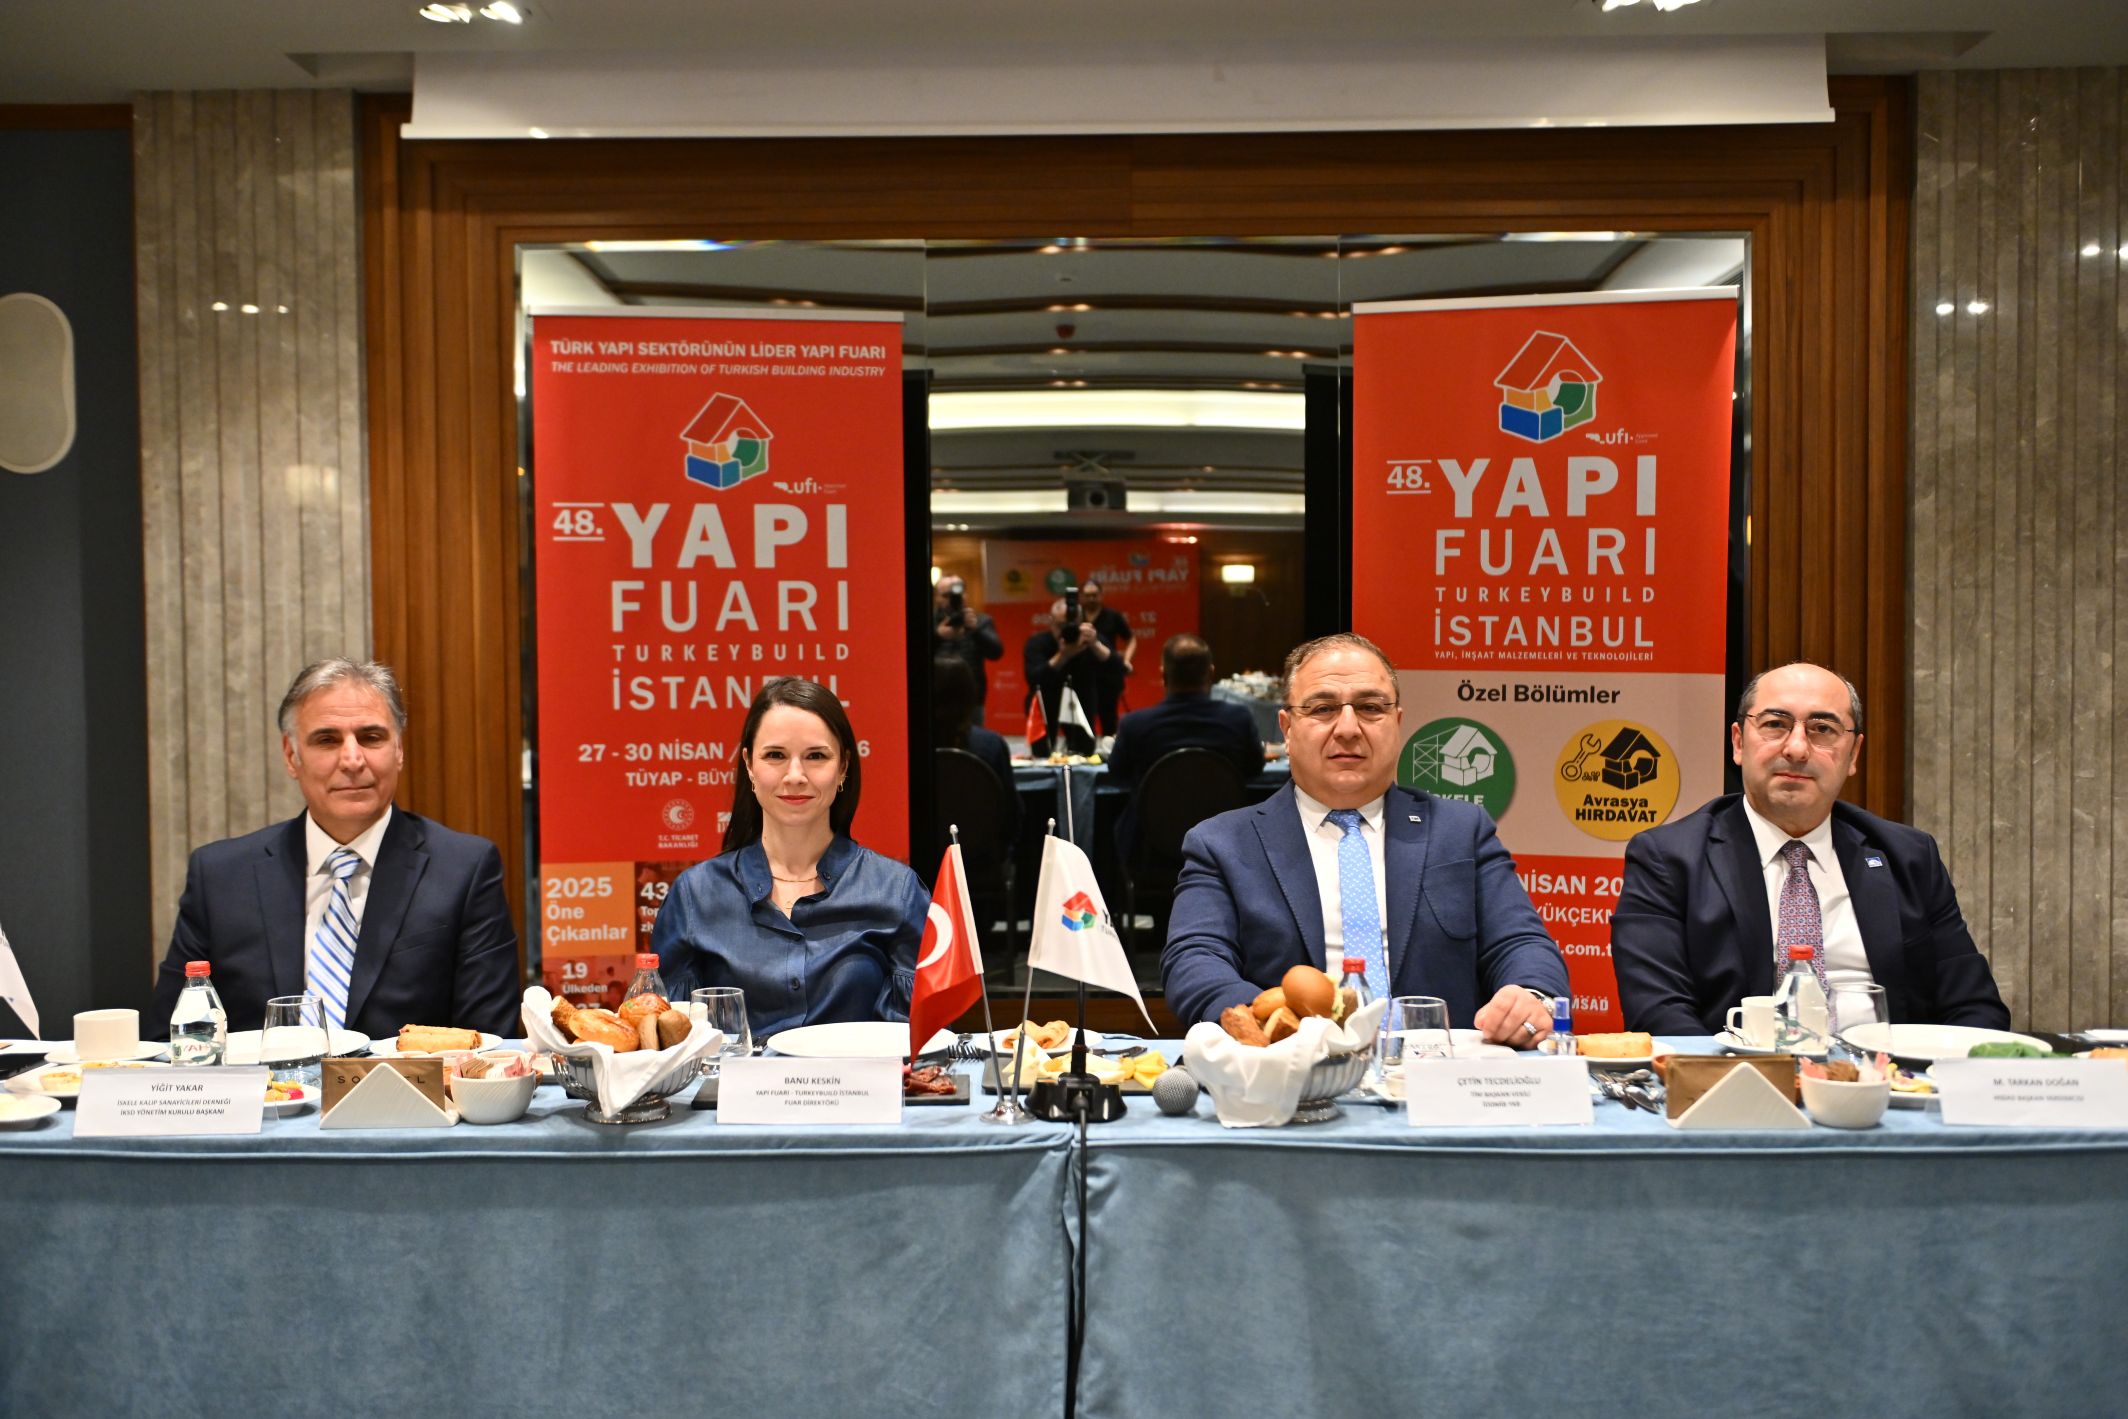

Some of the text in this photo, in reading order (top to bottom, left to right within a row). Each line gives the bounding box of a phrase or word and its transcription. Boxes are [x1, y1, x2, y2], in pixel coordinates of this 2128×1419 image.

[550, 338, 886, 359] TÜRK YAPI SEKTÖRÜNÜN LİDER YAPI FUARI
[552, 361, 886, 377] THE LEADING EXHIBITION OF TURKISH BUILDING INDUSTRY
[1387, 465, 1430, 489] 48.
[1437, 455, 1657, 518] YAPI
[553, 510, 603, 535] 48.
[611, 503, 848, 569] YAPI
[1435, 528, 1656, 576] FUARI
[1435, 587, 1655, 603] TURKEYBUILD
[611, 580, 849, 632] FUARI
[1434, 608, 1654, 647] İSTANBUL
[612, 644, 850, 662] TURKEYBUILD
[1434, 650, 1654, 662] YAPI, İNŞAAT MALZEMELERİ VE TEKNOLOJİLERİ
[612, 668, 850, 711] İSTANL
[1457, 680, 1621, 704] Özel Bölümler
[578, 744, 606, 762] 27
[624, 743, 652, 761] 30
[659, 739, 724, 760] NİSAN
[625, 768, 683, 787] TÜYAP
[1583, 794, 1649, 810] Avrasya
[1575, 808, 1657, 823] HIRDAVAT
[546, 877, 613, 899] 2025
[640, 882, 669, 901] 43
[1594, 877, 1624, 896] 20
[546, 901, 584, 920] Öne
[546, 925, 628, 945] Çıkanlar
[562, 962, 588, 980] 19
[562, 982, 608, 994] Ülkeden
[151, 1083, 204, 1092] YİĞİT YAKAR
[784, 1076, 841, 1085] BANU KESKİN
[137, 1108, 167, 1116] YÖNETİM
